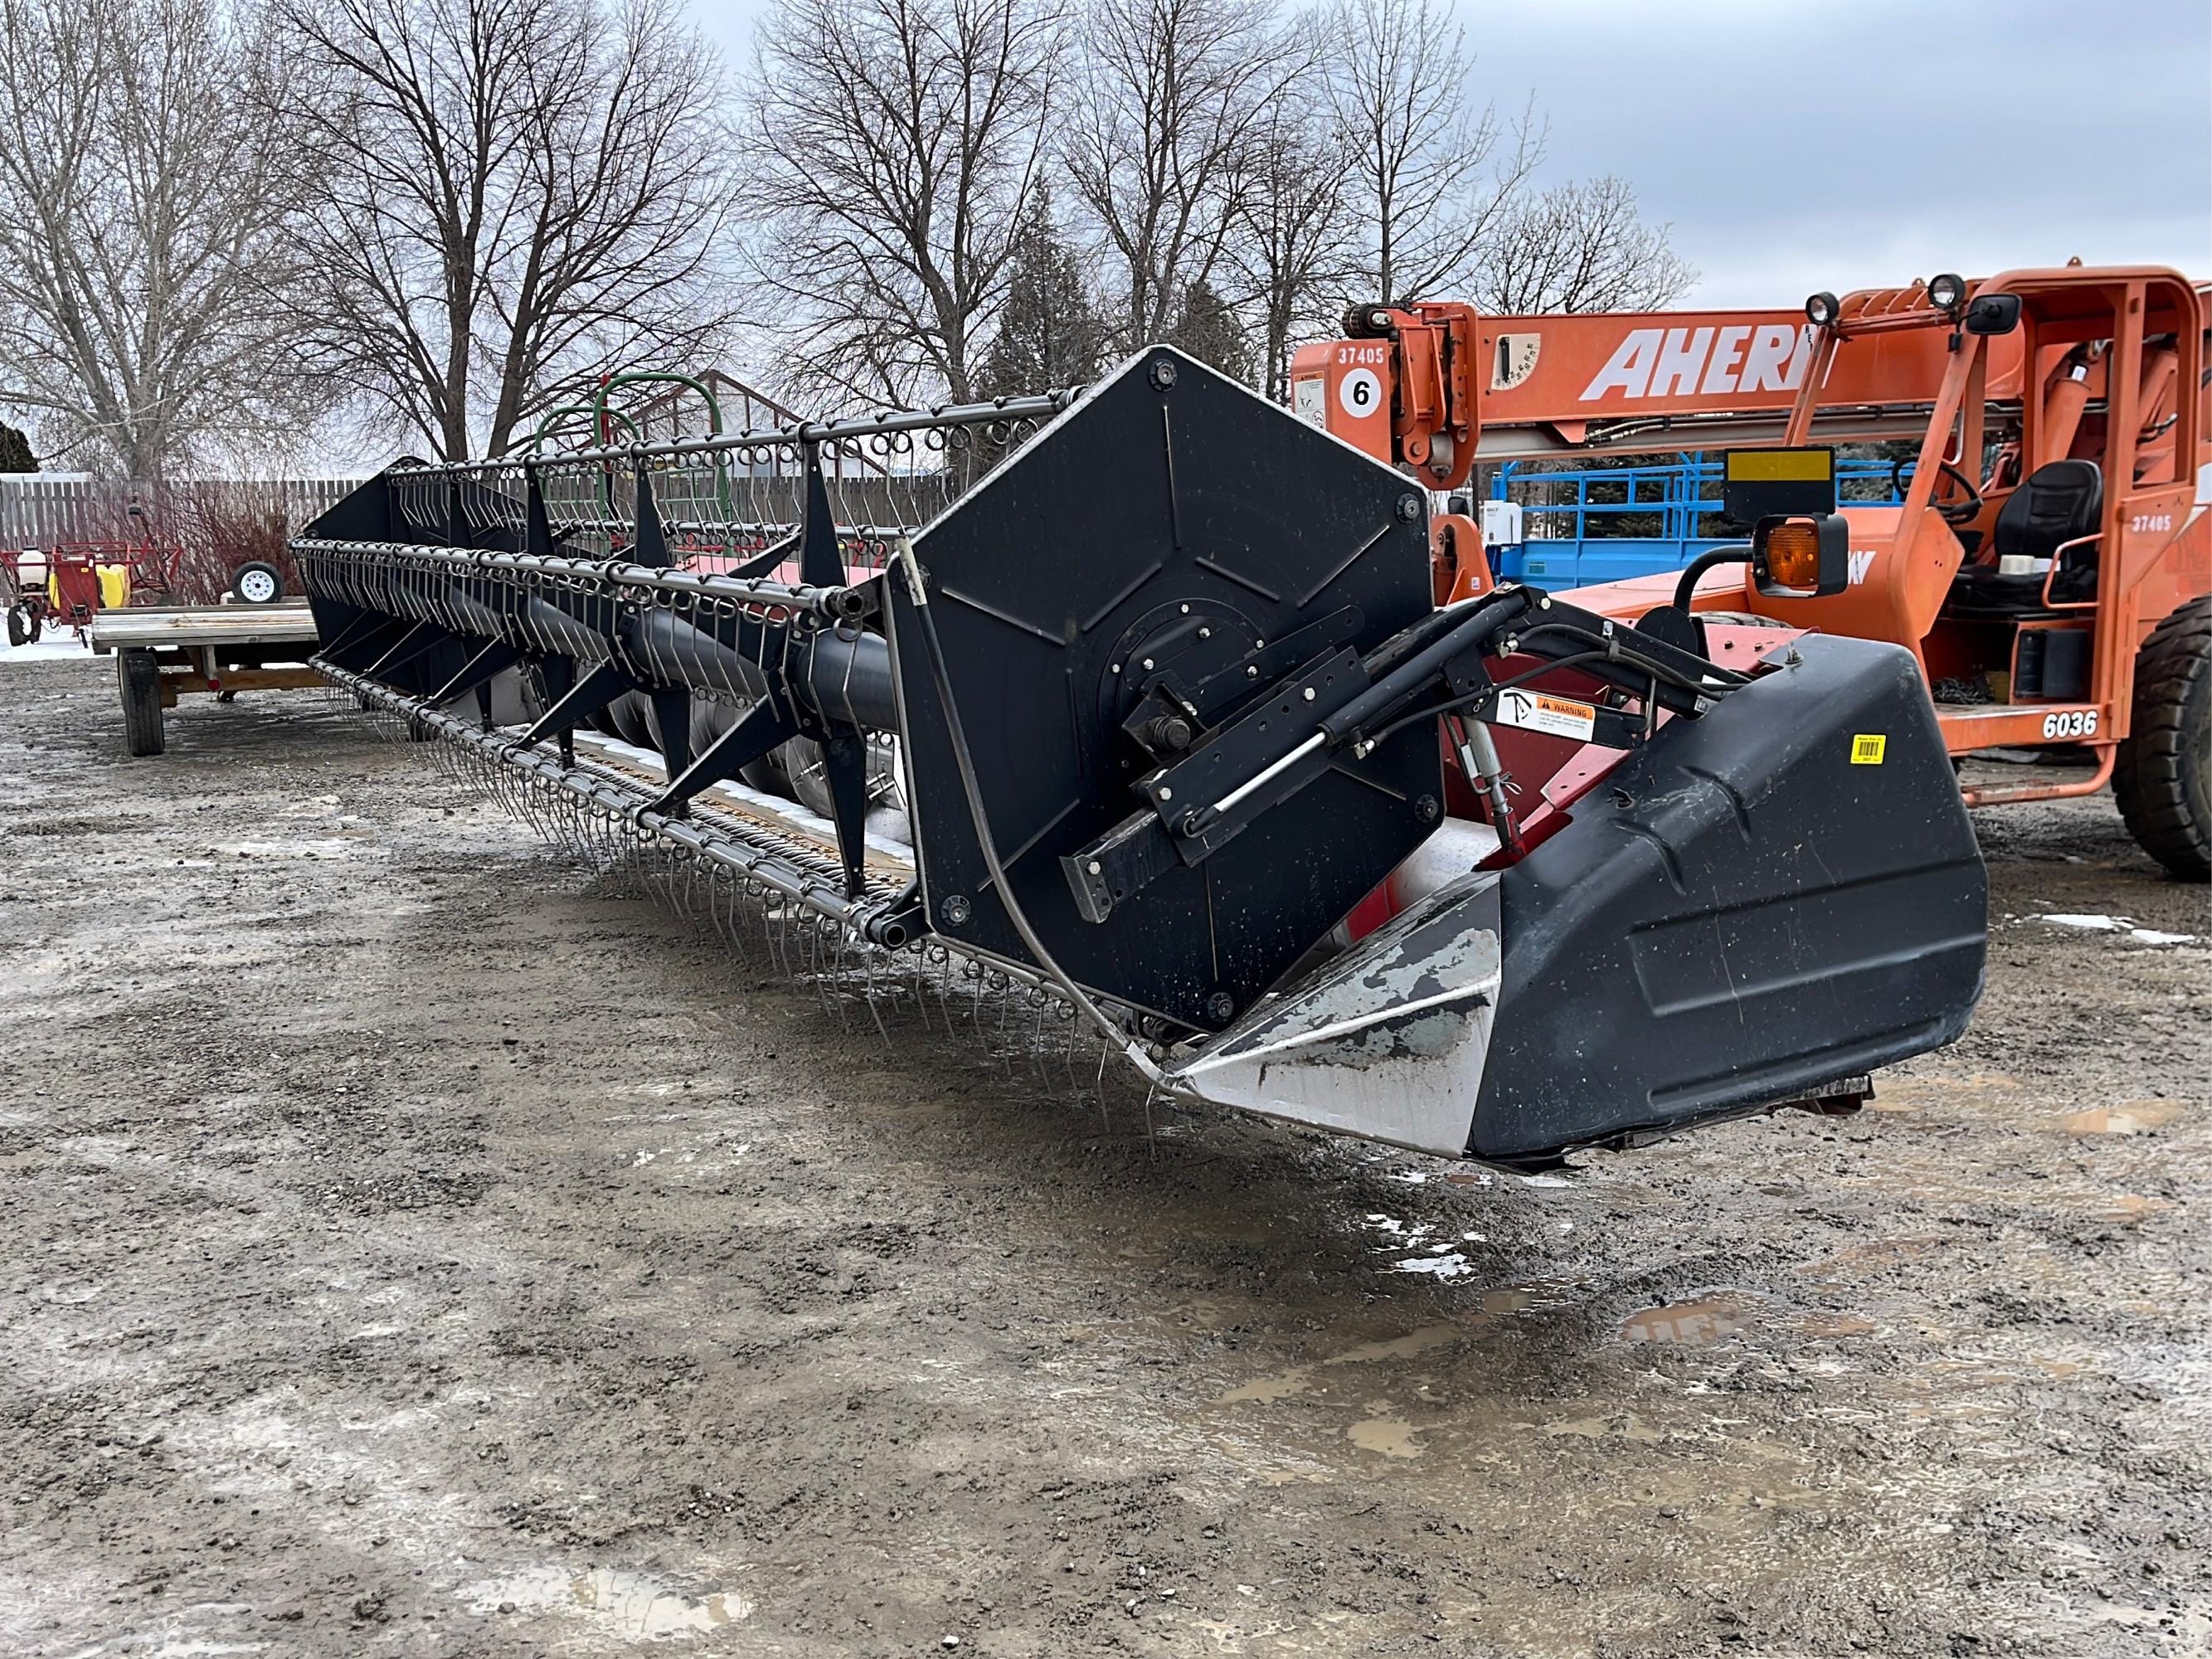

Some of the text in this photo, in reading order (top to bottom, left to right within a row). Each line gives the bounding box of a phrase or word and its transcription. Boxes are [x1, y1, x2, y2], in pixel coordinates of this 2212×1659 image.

[1338, 347, 1383, 364] 37405
[1353, 381, 1370, 406] 6
[2132, 514, 2171, 532] 37405
[1553, 703, 1587, 718] WARNING
[2043, 710, 2098, 739] 6036
